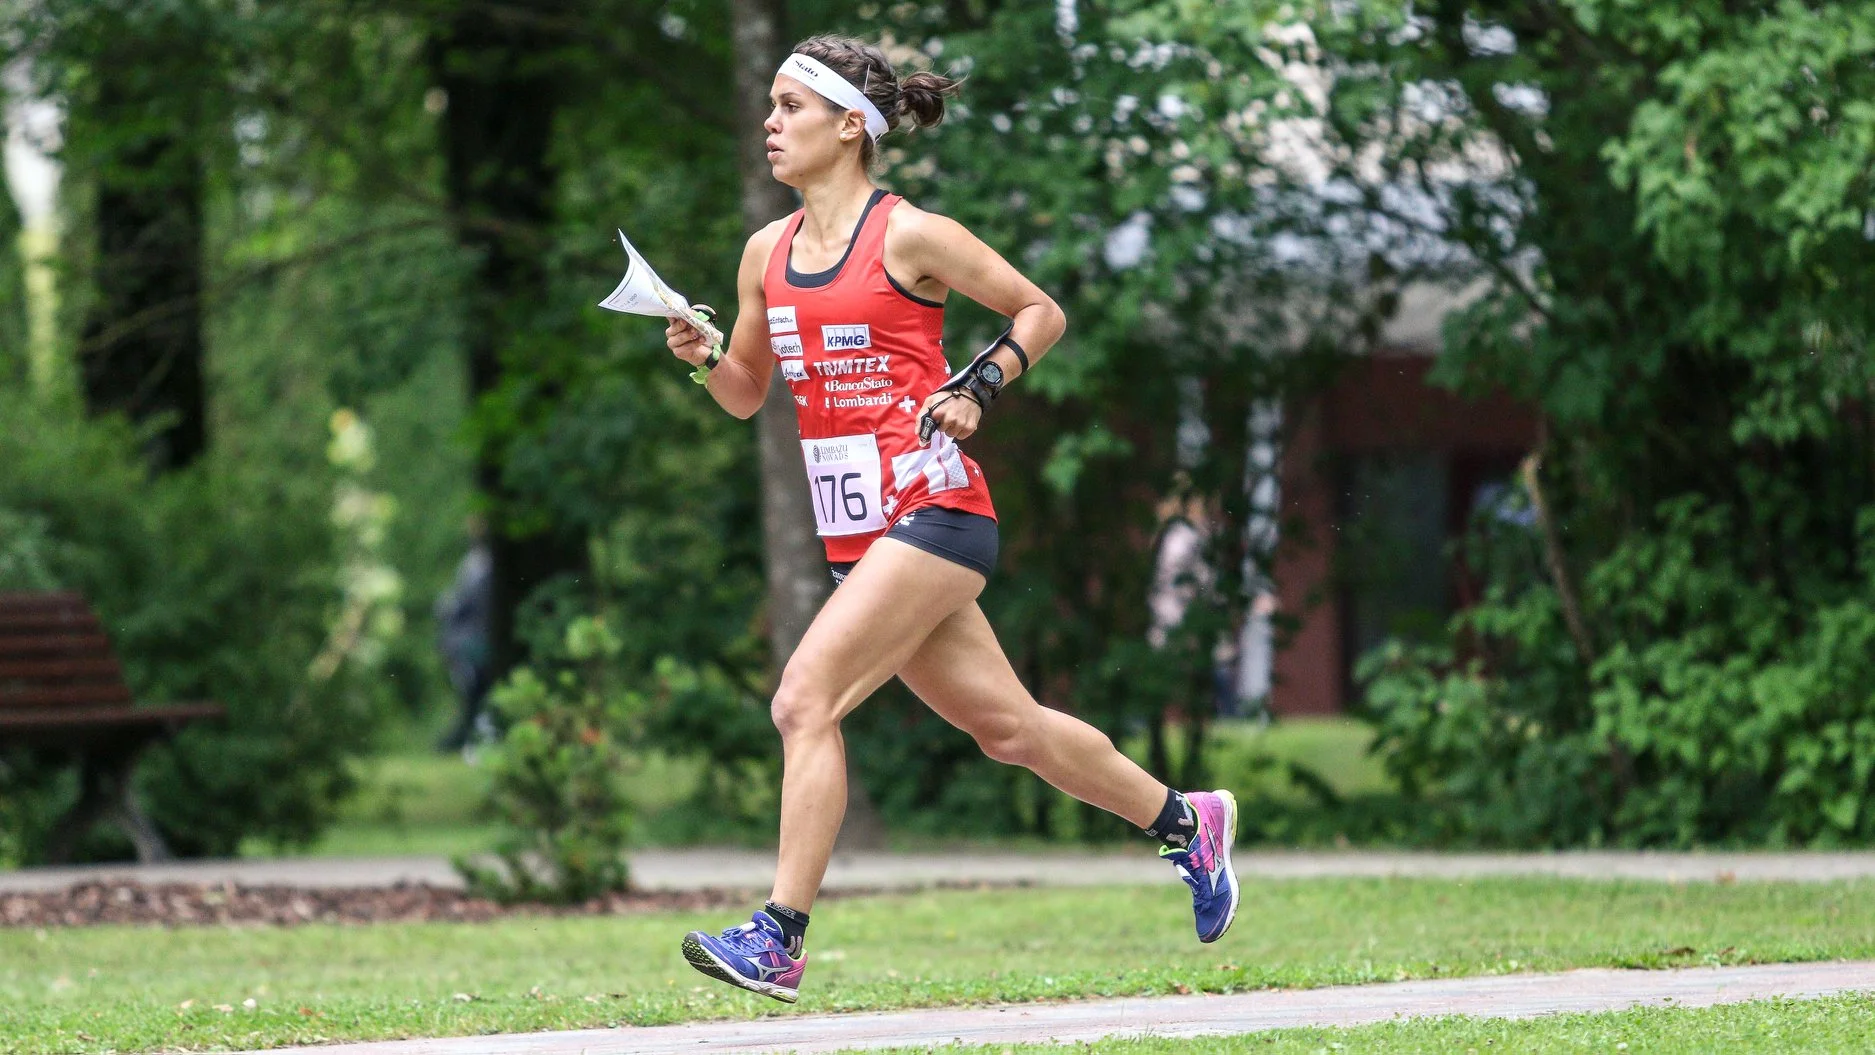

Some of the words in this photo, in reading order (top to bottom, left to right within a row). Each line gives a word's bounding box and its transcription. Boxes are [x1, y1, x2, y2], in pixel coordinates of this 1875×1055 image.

[827, 335, 865, 347] KPMG
[813, 354, 890, 376] TRIMTEX
[830, 376, 893, 392] BancaStato
[834, 392, 893, 408] Lombardi
[814, 472, 868, 523] 176
